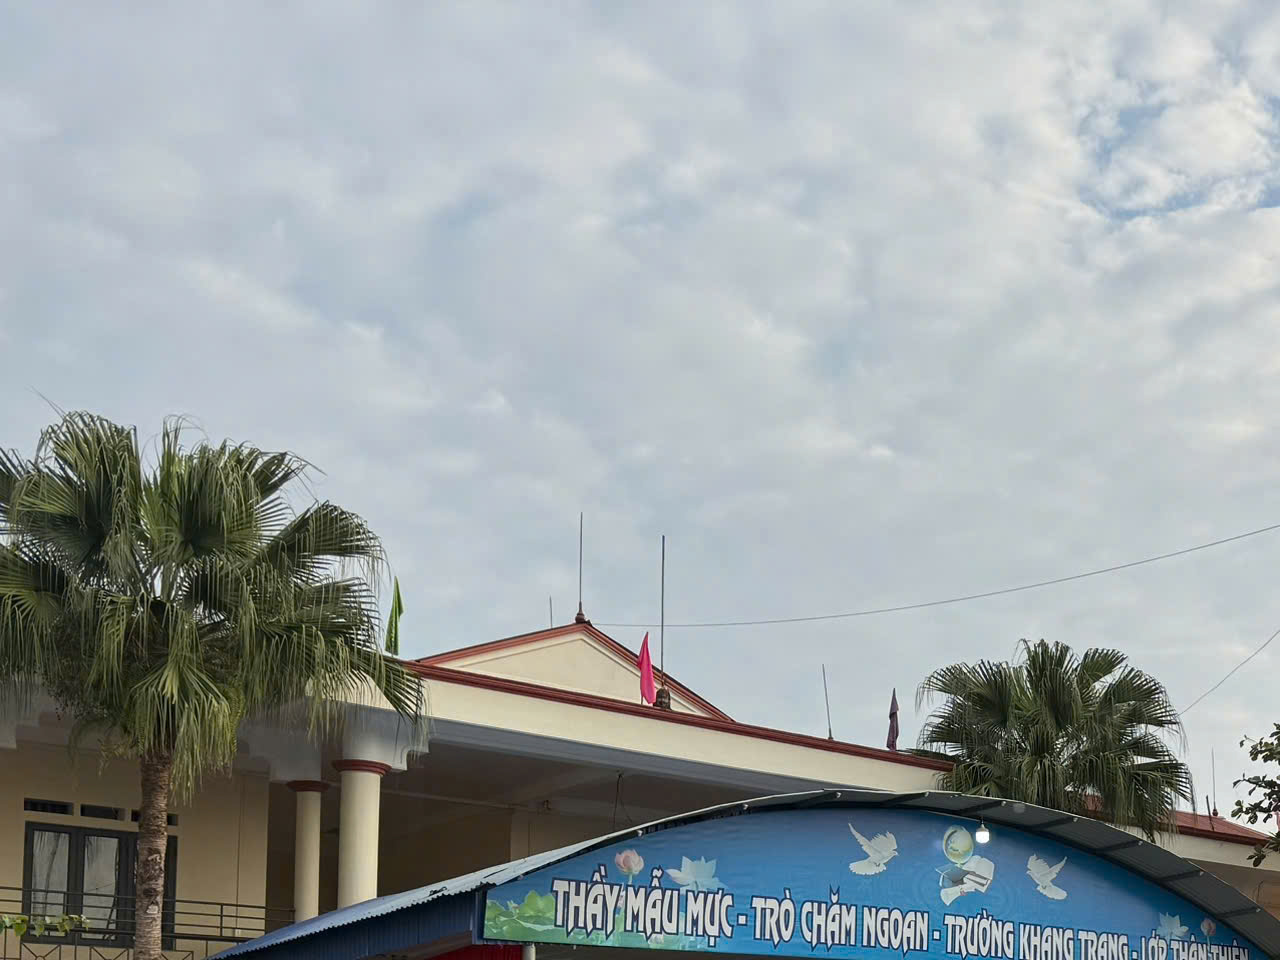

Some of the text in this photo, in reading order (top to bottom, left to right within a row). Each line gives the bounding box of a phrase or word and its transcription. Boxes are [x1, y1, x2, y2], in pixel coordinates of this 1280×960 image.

[552, 864, 623, 939] THẦY
[624, 865, 680, 940] MẪU
[685, 887, 735, 947] MỰC
[751, 887, 796, 949] TRÒ
[801, 884, 857, 951] CHĂM
[862, 905, 929, 957] NGOAN
[944, 907, 1014, 960] TRƯỜNG
